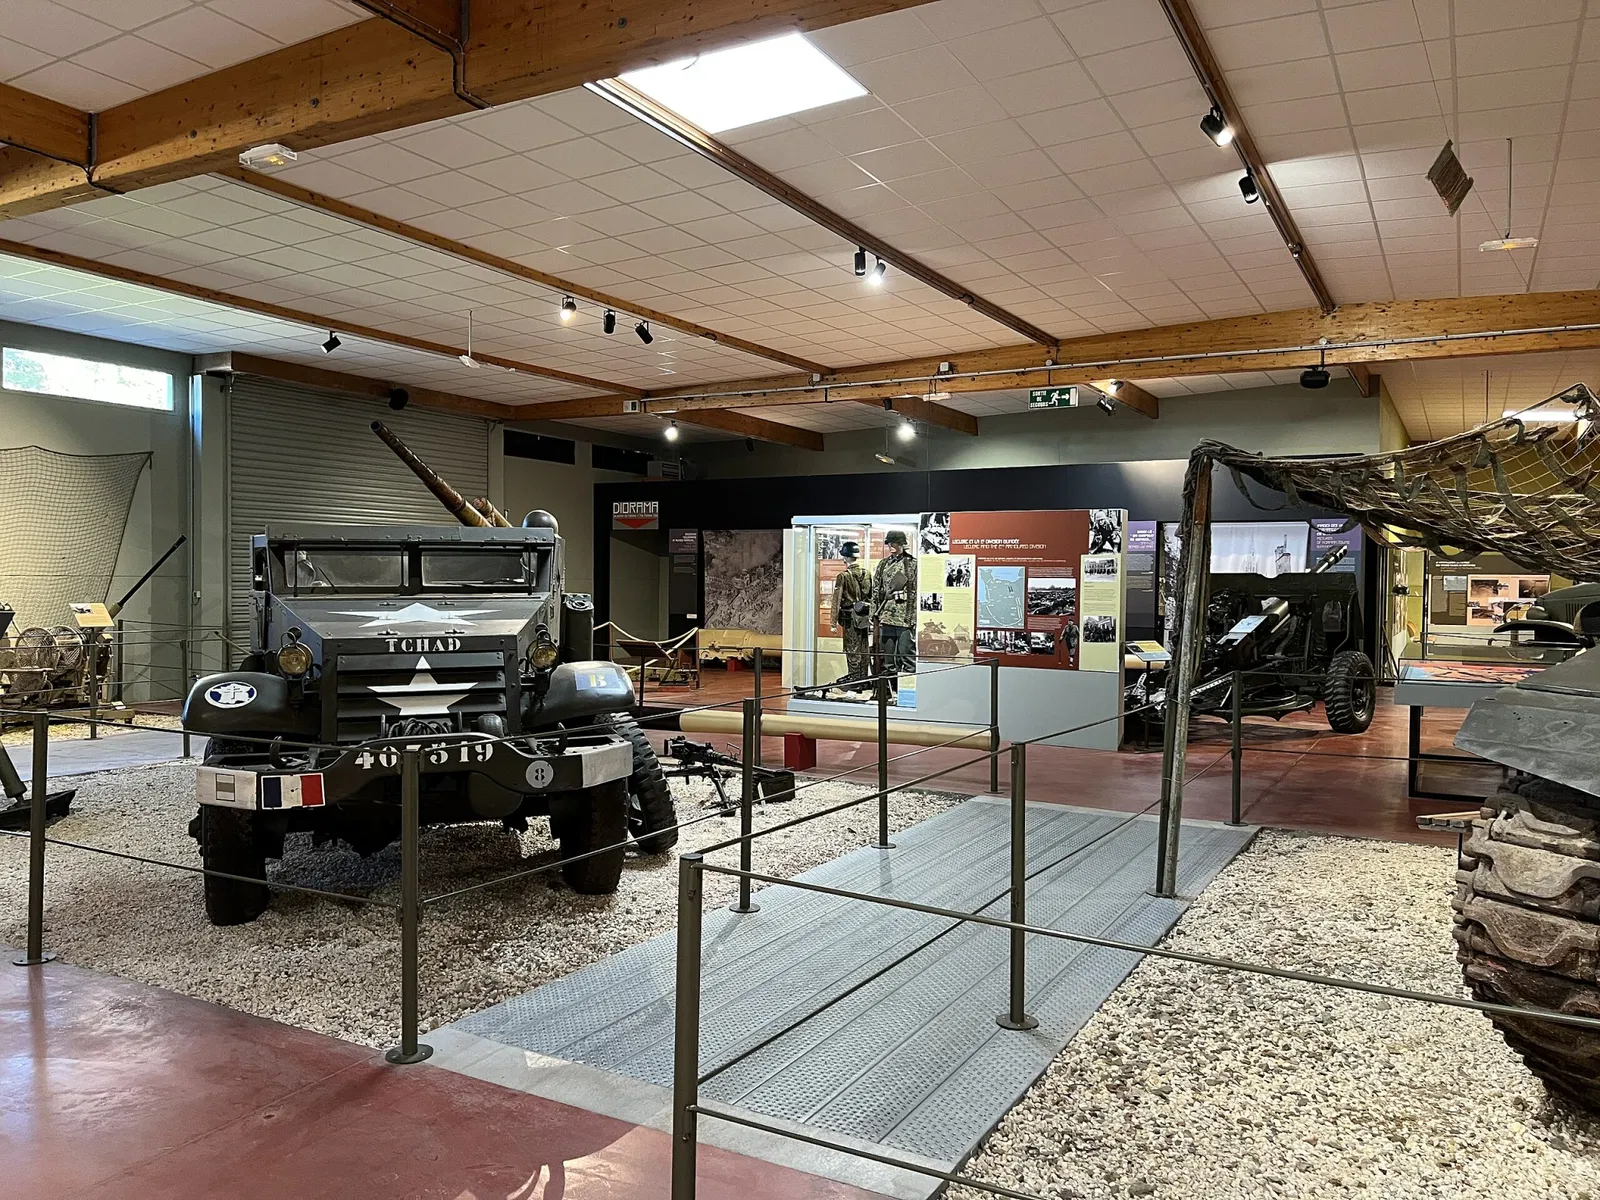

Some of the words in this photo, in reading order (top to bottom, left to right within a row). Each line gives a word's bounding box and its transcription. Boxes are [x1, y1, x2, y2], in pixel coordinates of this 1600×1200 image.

[613, 501, 659, 514] DIORAMA
[385, 638, 462, 653] TCHAD
[534, 767, 546, 781] 8
